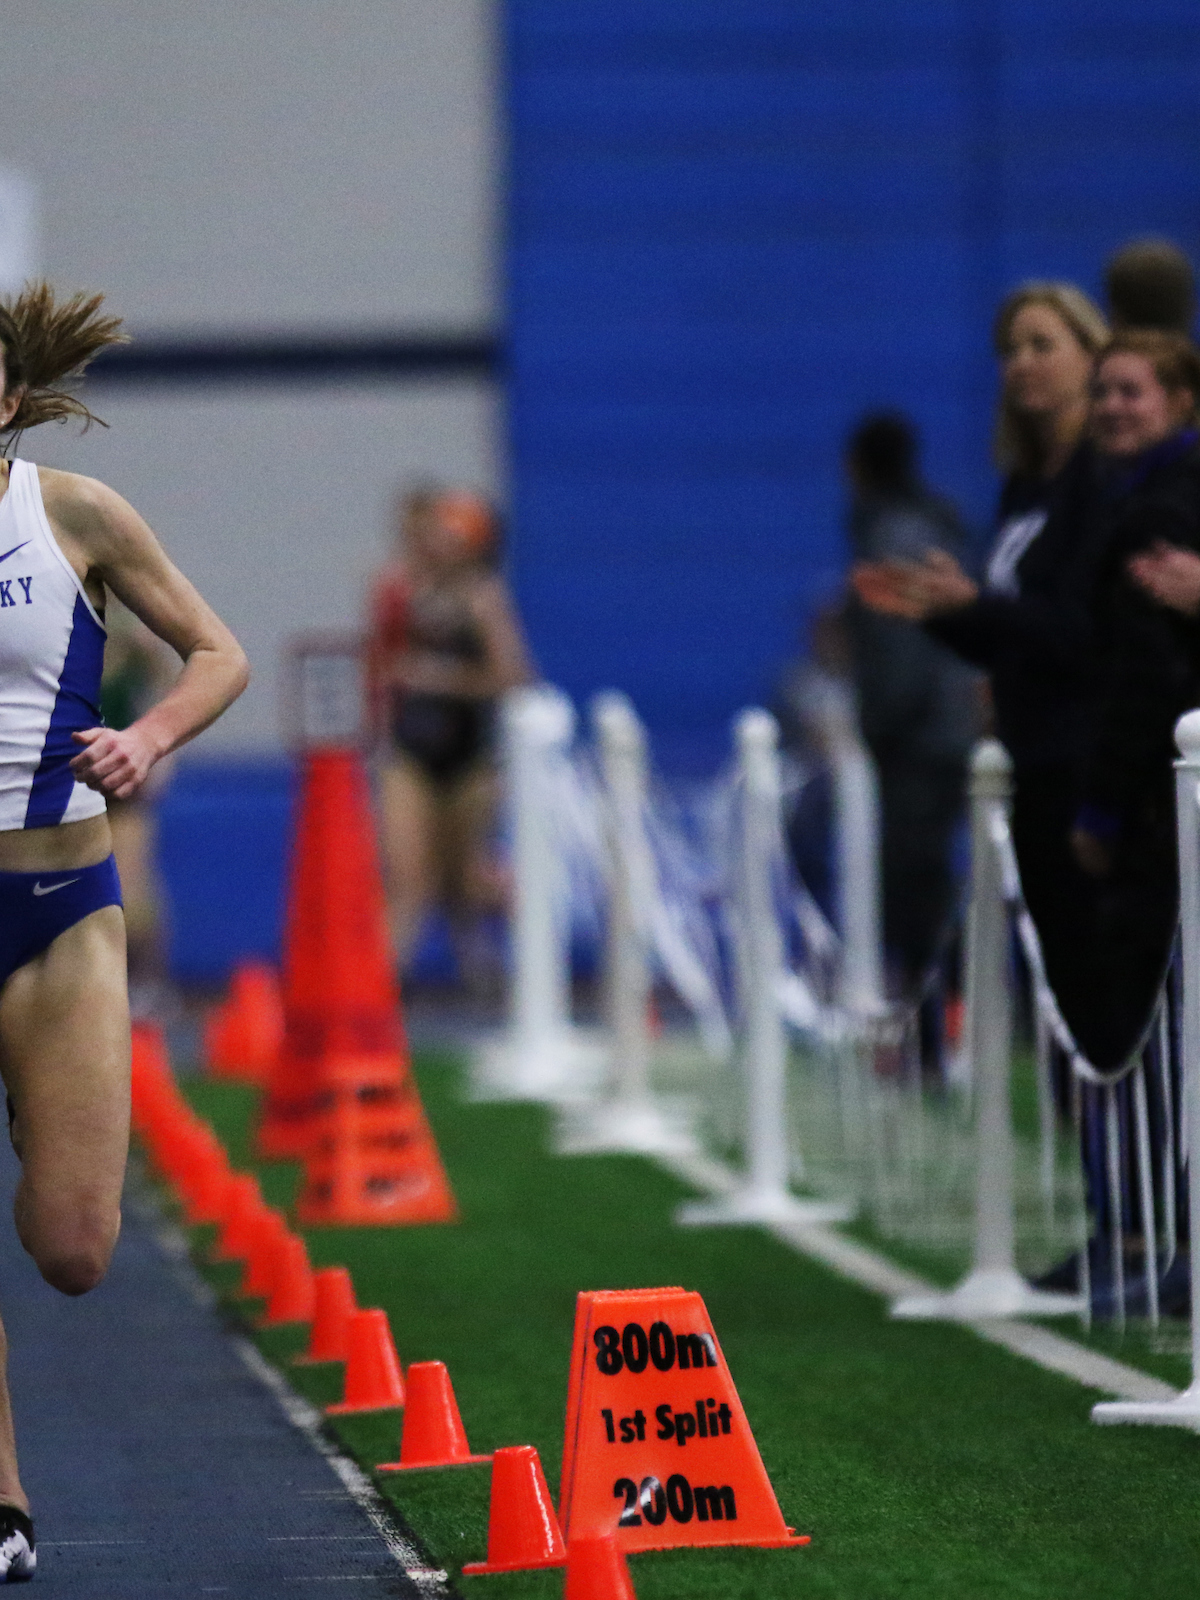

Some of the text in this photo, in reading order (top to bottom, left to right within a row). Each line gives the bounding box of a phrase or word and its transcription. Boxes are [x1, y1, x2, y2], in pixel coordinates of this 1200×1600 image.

[594, 1321, 717, 1375] 800m
[601, 1398, 732, 1446] 1st Split
[613, 1473, 738, 1527] 200m
